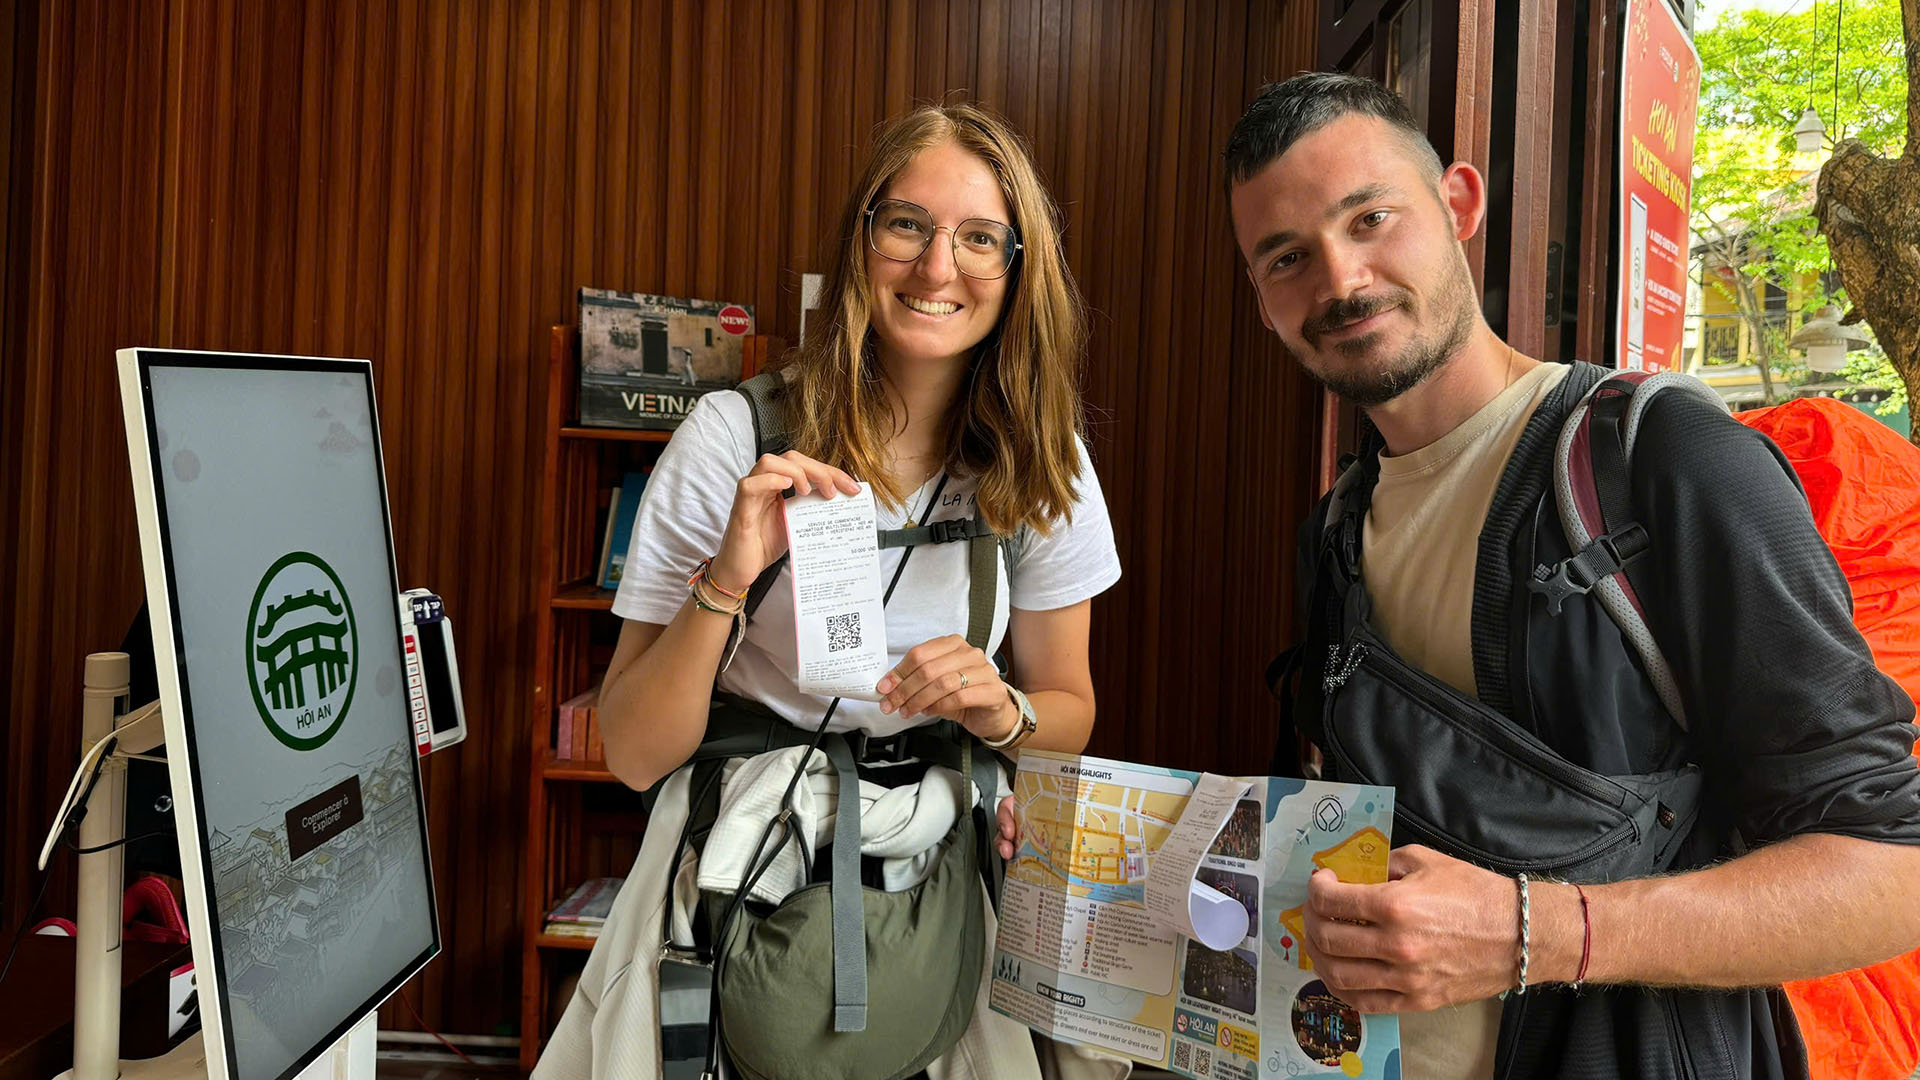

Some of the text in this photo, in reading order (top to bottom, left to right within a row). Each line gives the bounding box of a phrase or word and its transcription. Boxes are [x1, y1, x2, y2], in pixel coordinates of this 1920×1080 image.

[1631, 133, 1670, 199] TICKETING
[720, 315, 750, 326] NEW!
[621, 391, 697, 415] VIETNA
[942, 494, 961, 506] LA
[413, 601, 441, 612] TAP TAP
[296, 704, 332, 730] HỘI AN
[1077, 768, 1112, 780] HIGHLIGHTS
[302, 798, 343, 828] Commencer
[312, 811, 341, 834] Explorer
[1063, 993, 1084, 1006] RIGHTS
[1079, 1013, 1102, 1025] according
[1108, 1020, 1130, 1031] structure
[1138, 1026, 1146, 1035] the
[1147, 1029, 1161, 1039] ticket
[1204, 1022, 1216, 1034] AN
[1128, 1039, 1140, 1048] dress
